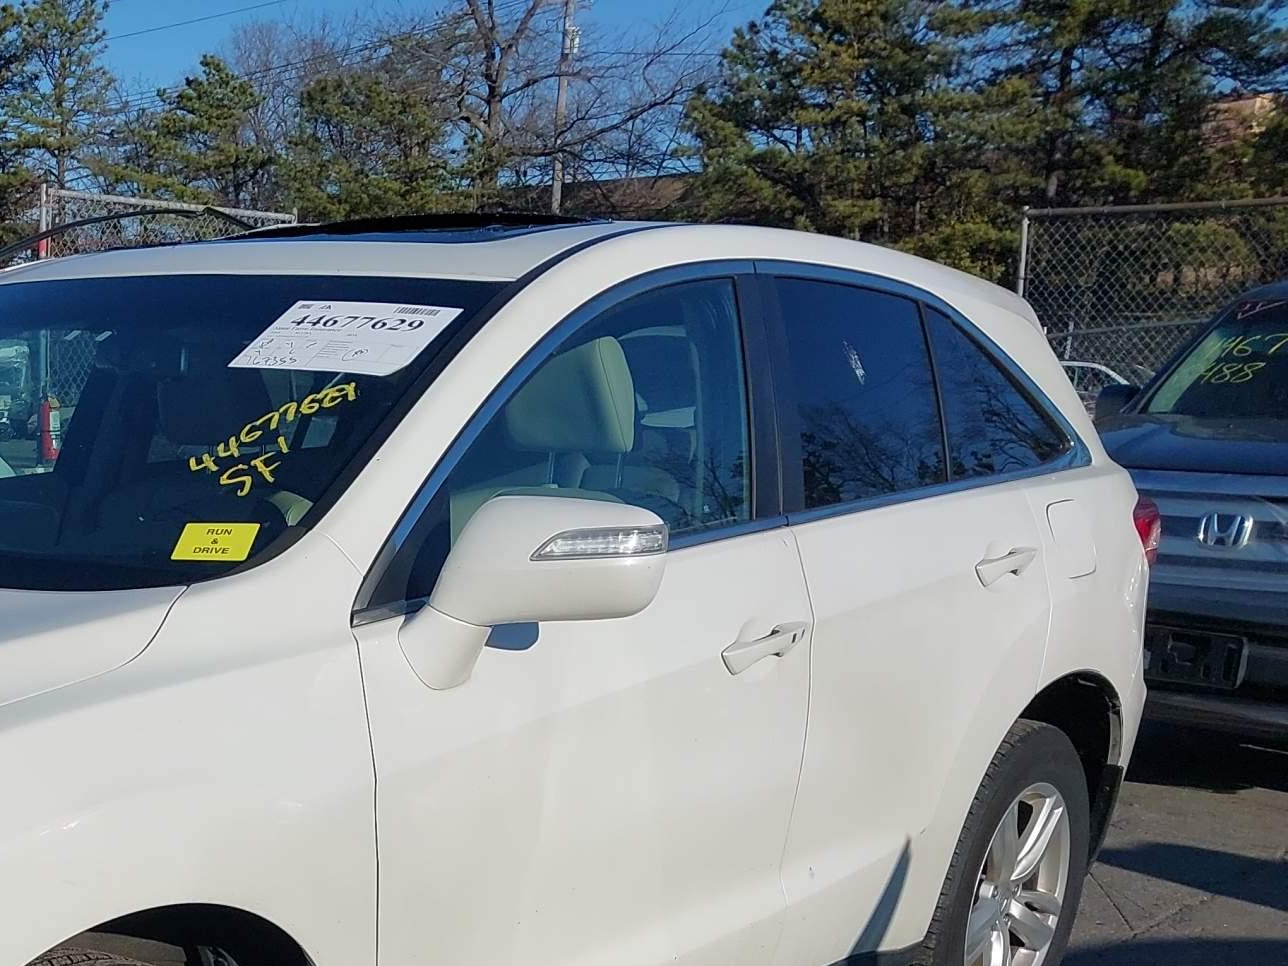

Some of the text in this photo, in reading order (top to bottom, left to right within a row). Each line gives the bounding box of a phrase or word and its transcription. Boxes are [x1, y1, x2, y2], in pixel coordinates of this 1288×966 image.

[289, 313, 426, 332] 44677629
[206, 528, 233, 536] RUN
[210, 537, 219, 545] &
[192, 547, 230, 555] DRIVE
